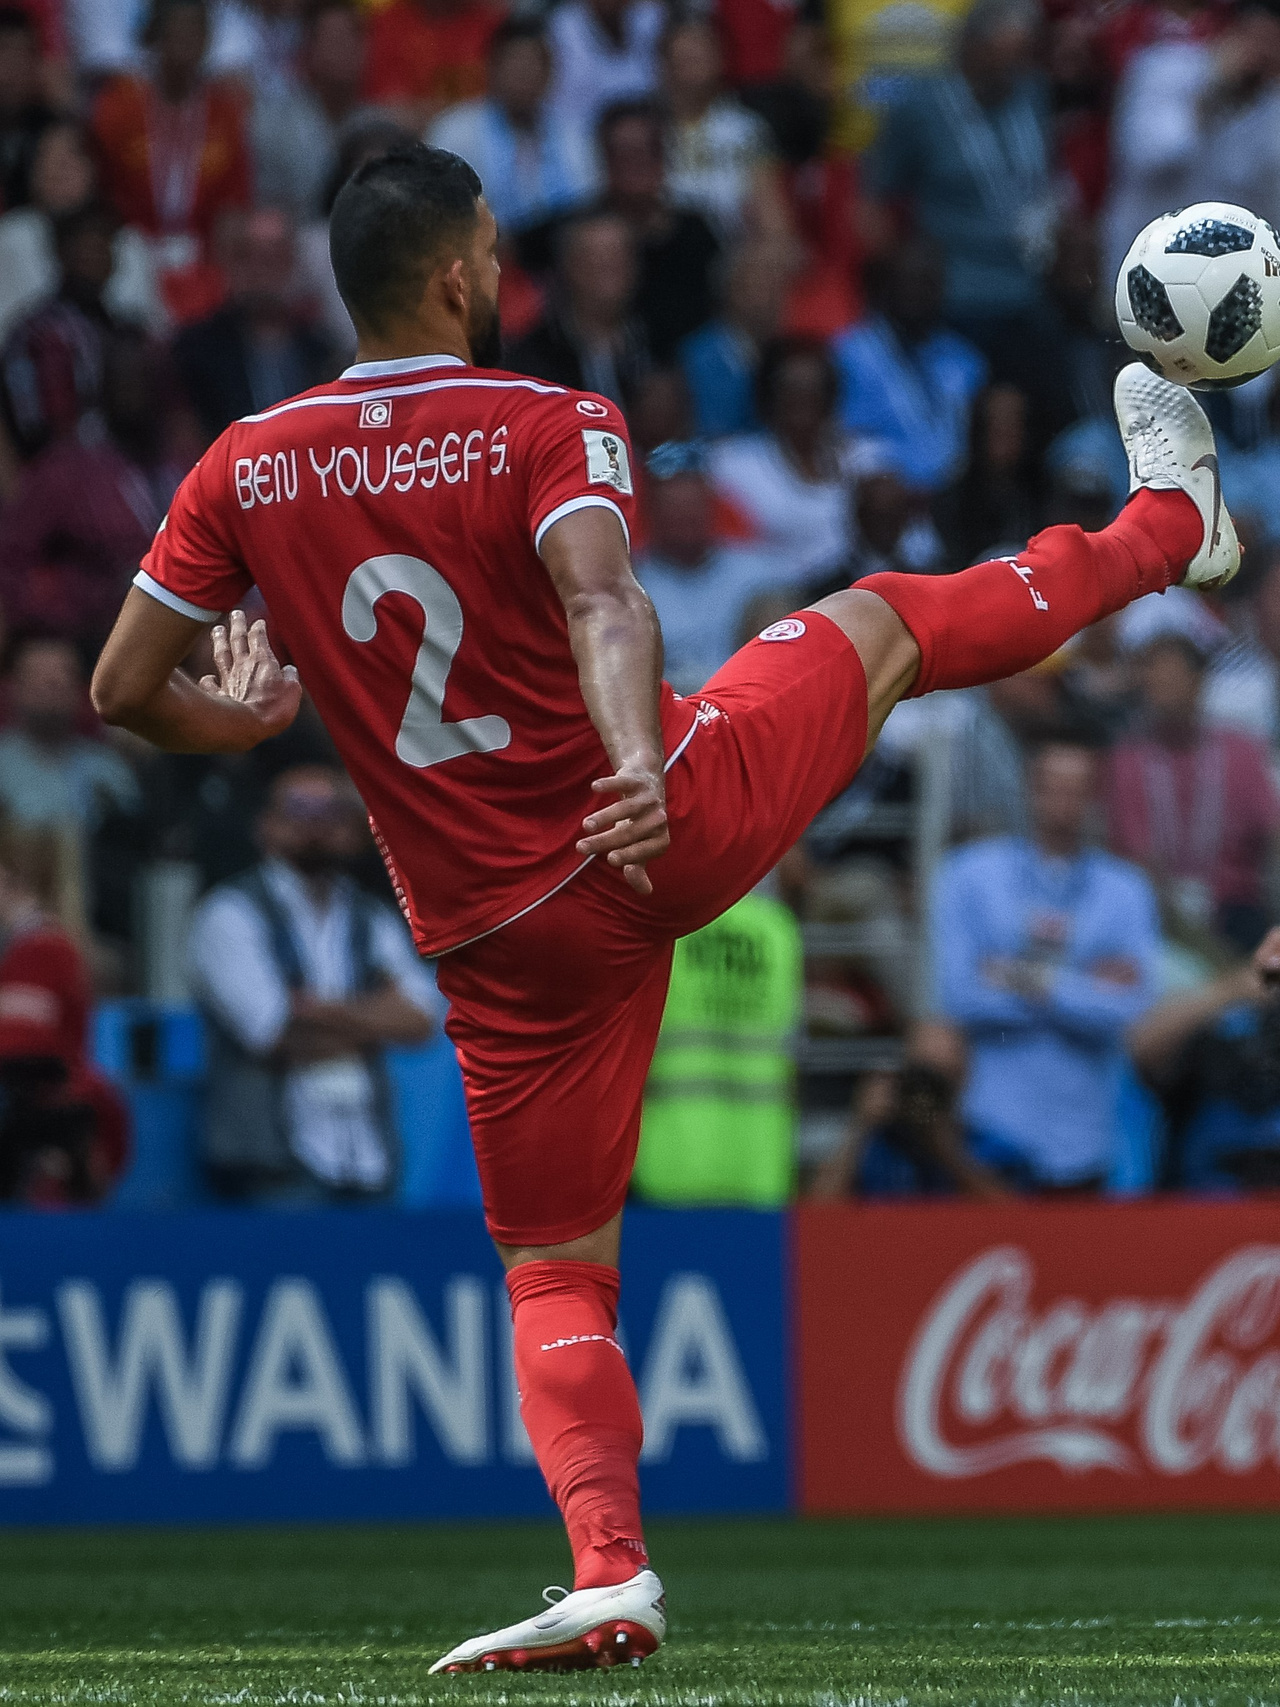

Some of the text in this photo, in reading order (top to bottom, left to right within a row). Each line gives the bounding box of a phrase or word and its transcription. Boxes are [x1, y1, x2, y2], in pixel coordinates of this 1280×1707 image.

[234, 448, 298, 510] BEN
[307, 428, 484, 498] YOUSSEF
[342, 553, 511, 768] 2
[56, 1271, 770, 1474] WANA
